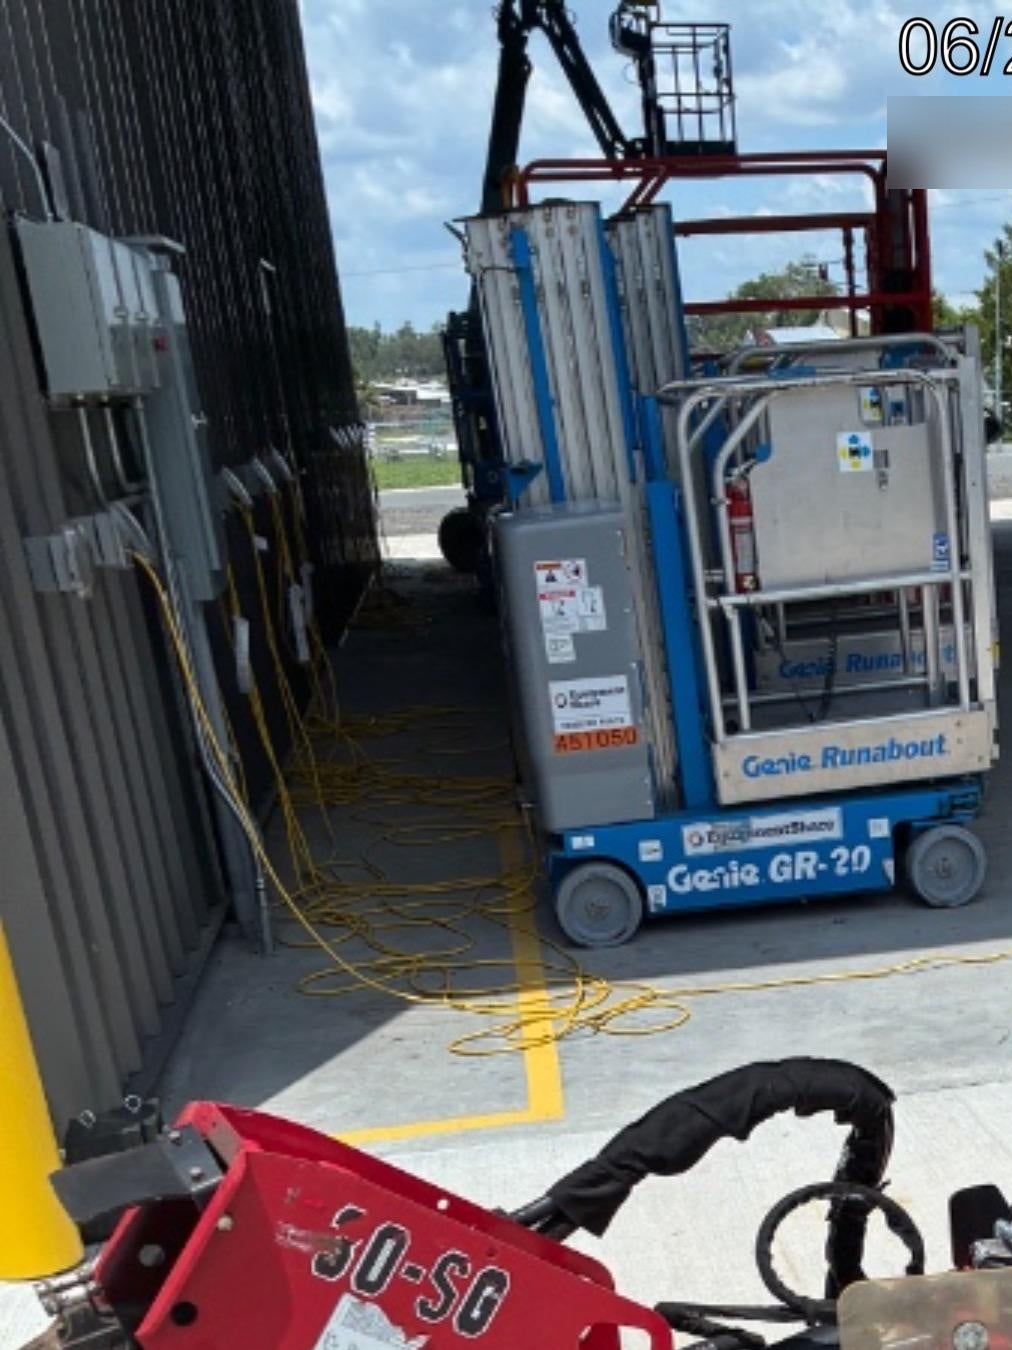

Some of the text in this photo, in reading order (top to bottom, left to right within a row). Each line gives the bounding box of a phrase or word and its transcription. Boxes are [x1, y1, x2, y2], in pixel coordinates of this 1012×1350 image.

[742, 733, 946, 778] Genie Runabout
[667, 845, 872, 894] Genie GR-20
